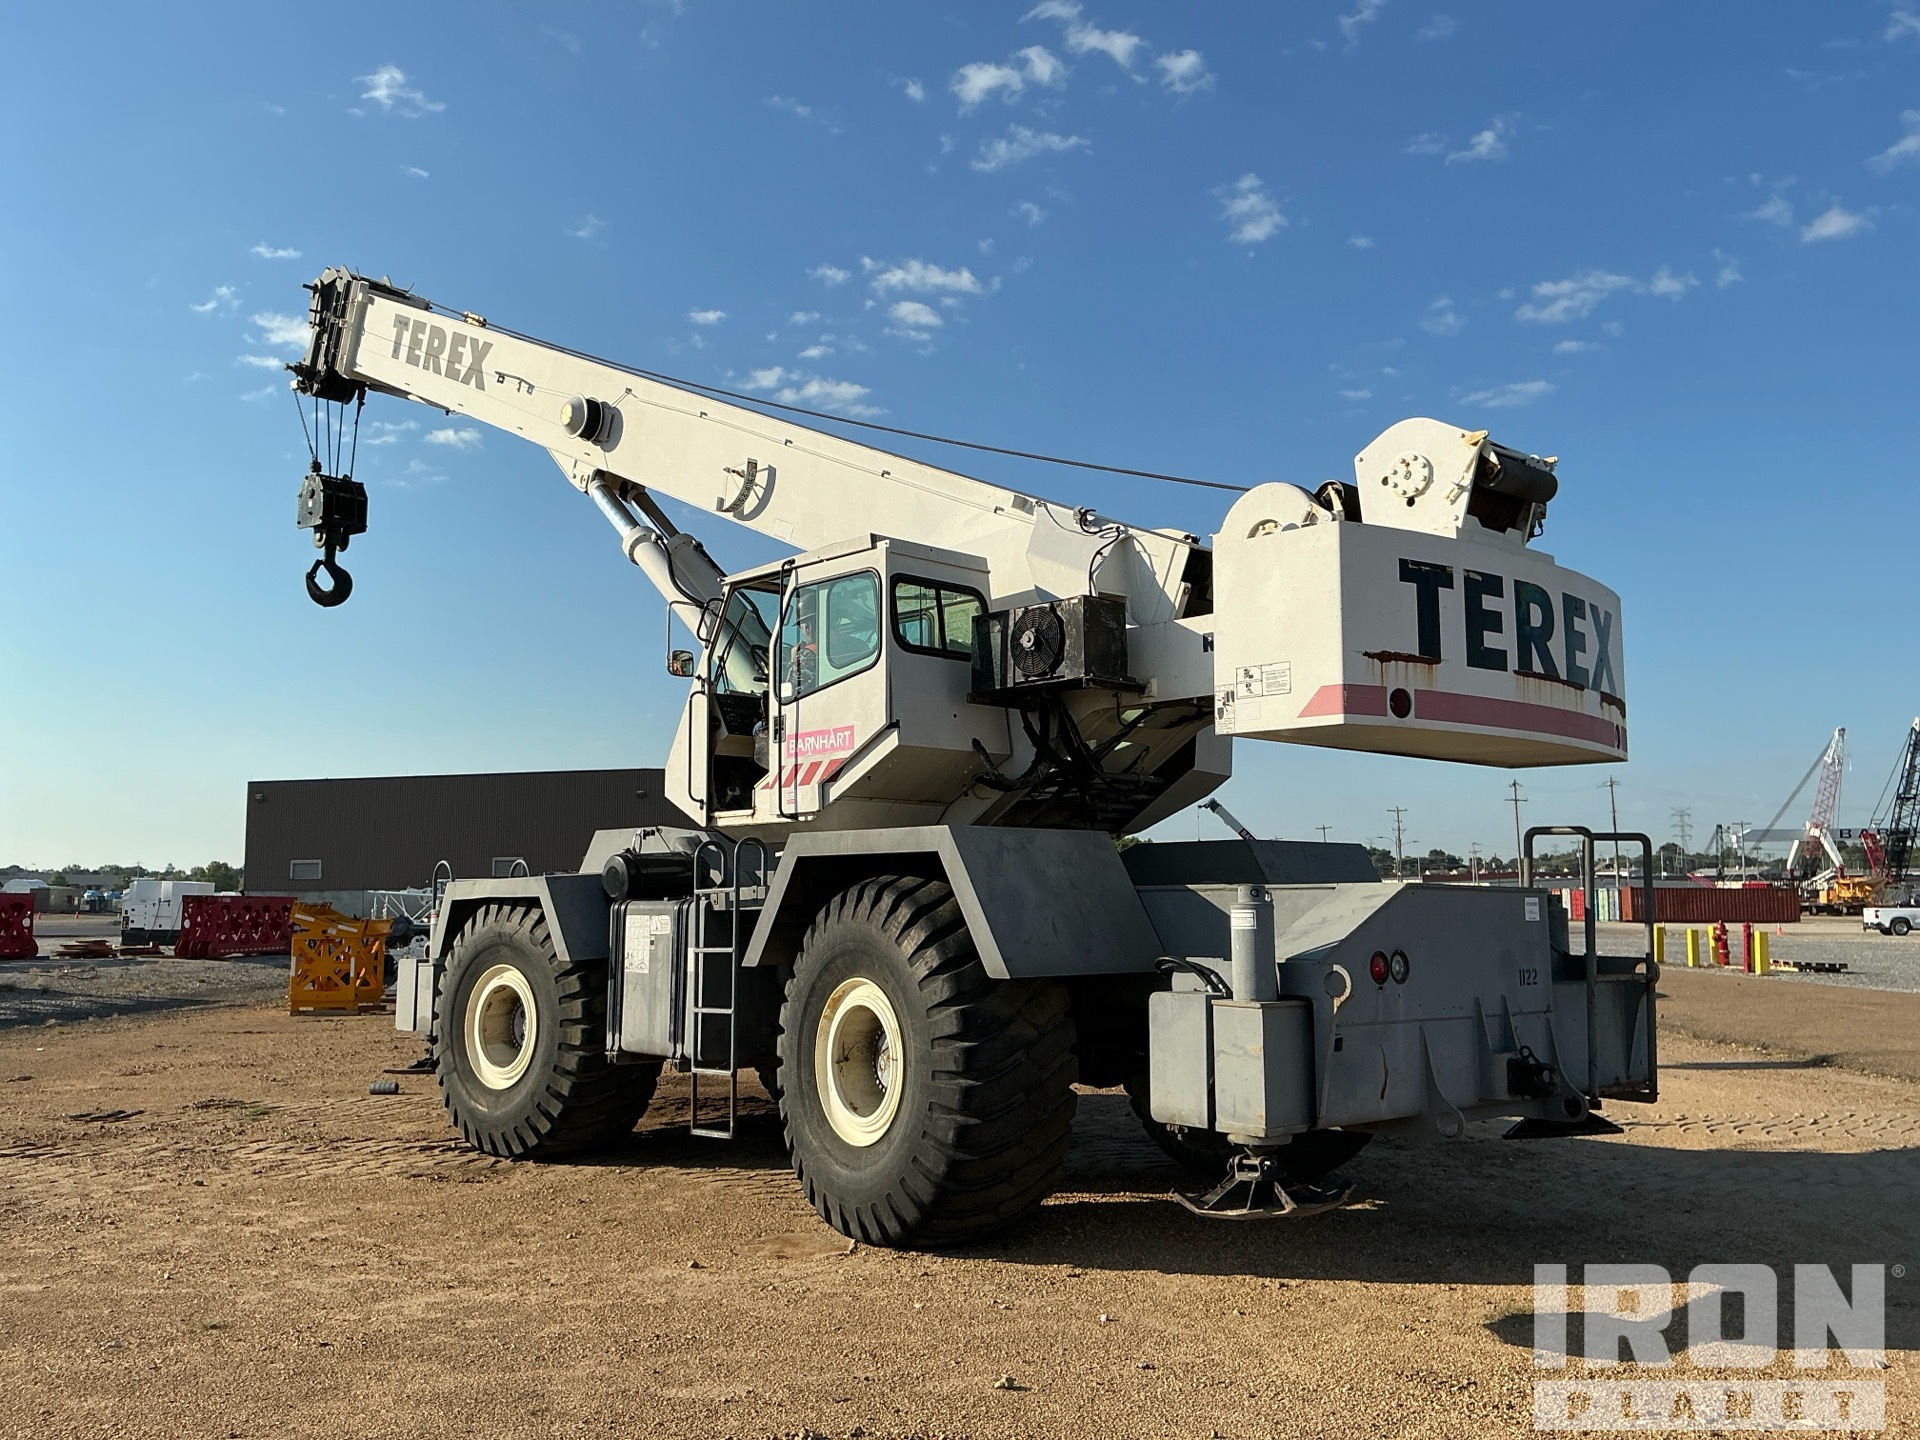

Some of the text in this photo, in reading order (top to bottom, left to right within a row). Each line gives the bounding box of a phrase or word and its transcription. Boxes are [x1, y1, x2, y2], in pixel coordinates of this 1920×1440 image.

[388, 313, 494, 392] TEREX
[1398, 557, 1617, 697] TEREX
[789, 728, 851, 756] BARNHART
[1518, 968, 1538, 987] 1122
